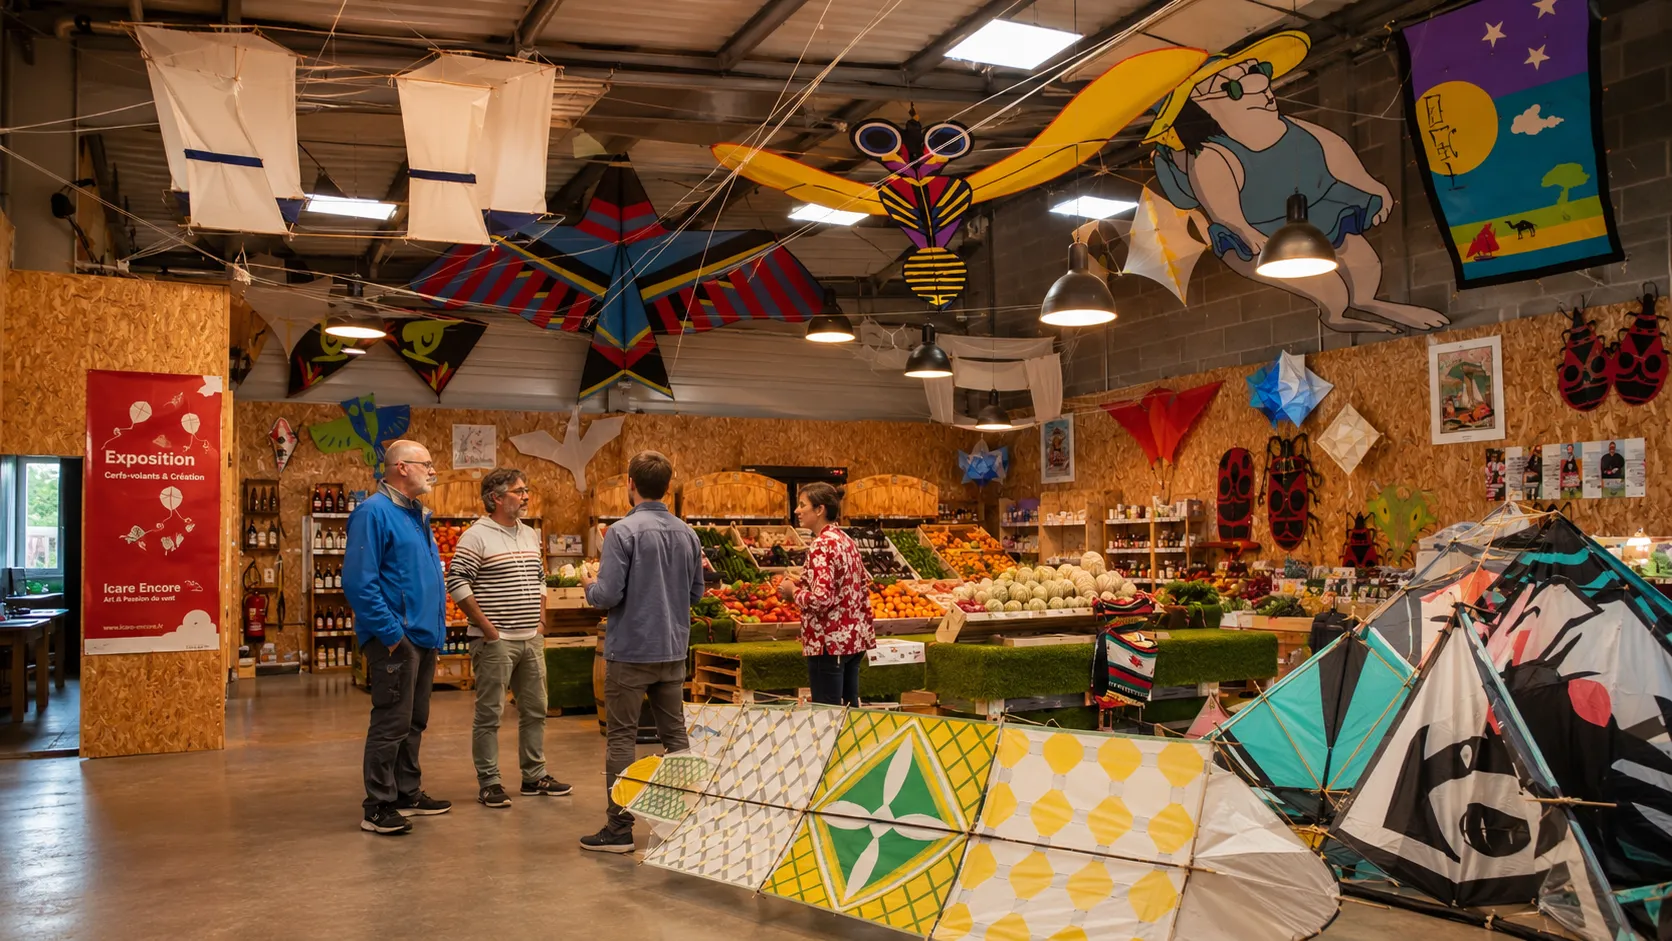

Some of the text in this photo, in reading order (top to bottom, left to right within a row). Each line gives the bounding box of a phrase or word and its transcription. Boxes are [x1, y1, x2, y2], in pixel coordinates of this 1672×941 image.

[105, 449, 195, 468] Exposition
[104, 471, 205, 481] Cerfs-volants & Création
[103, 582, 181, 594] Icare Encore
